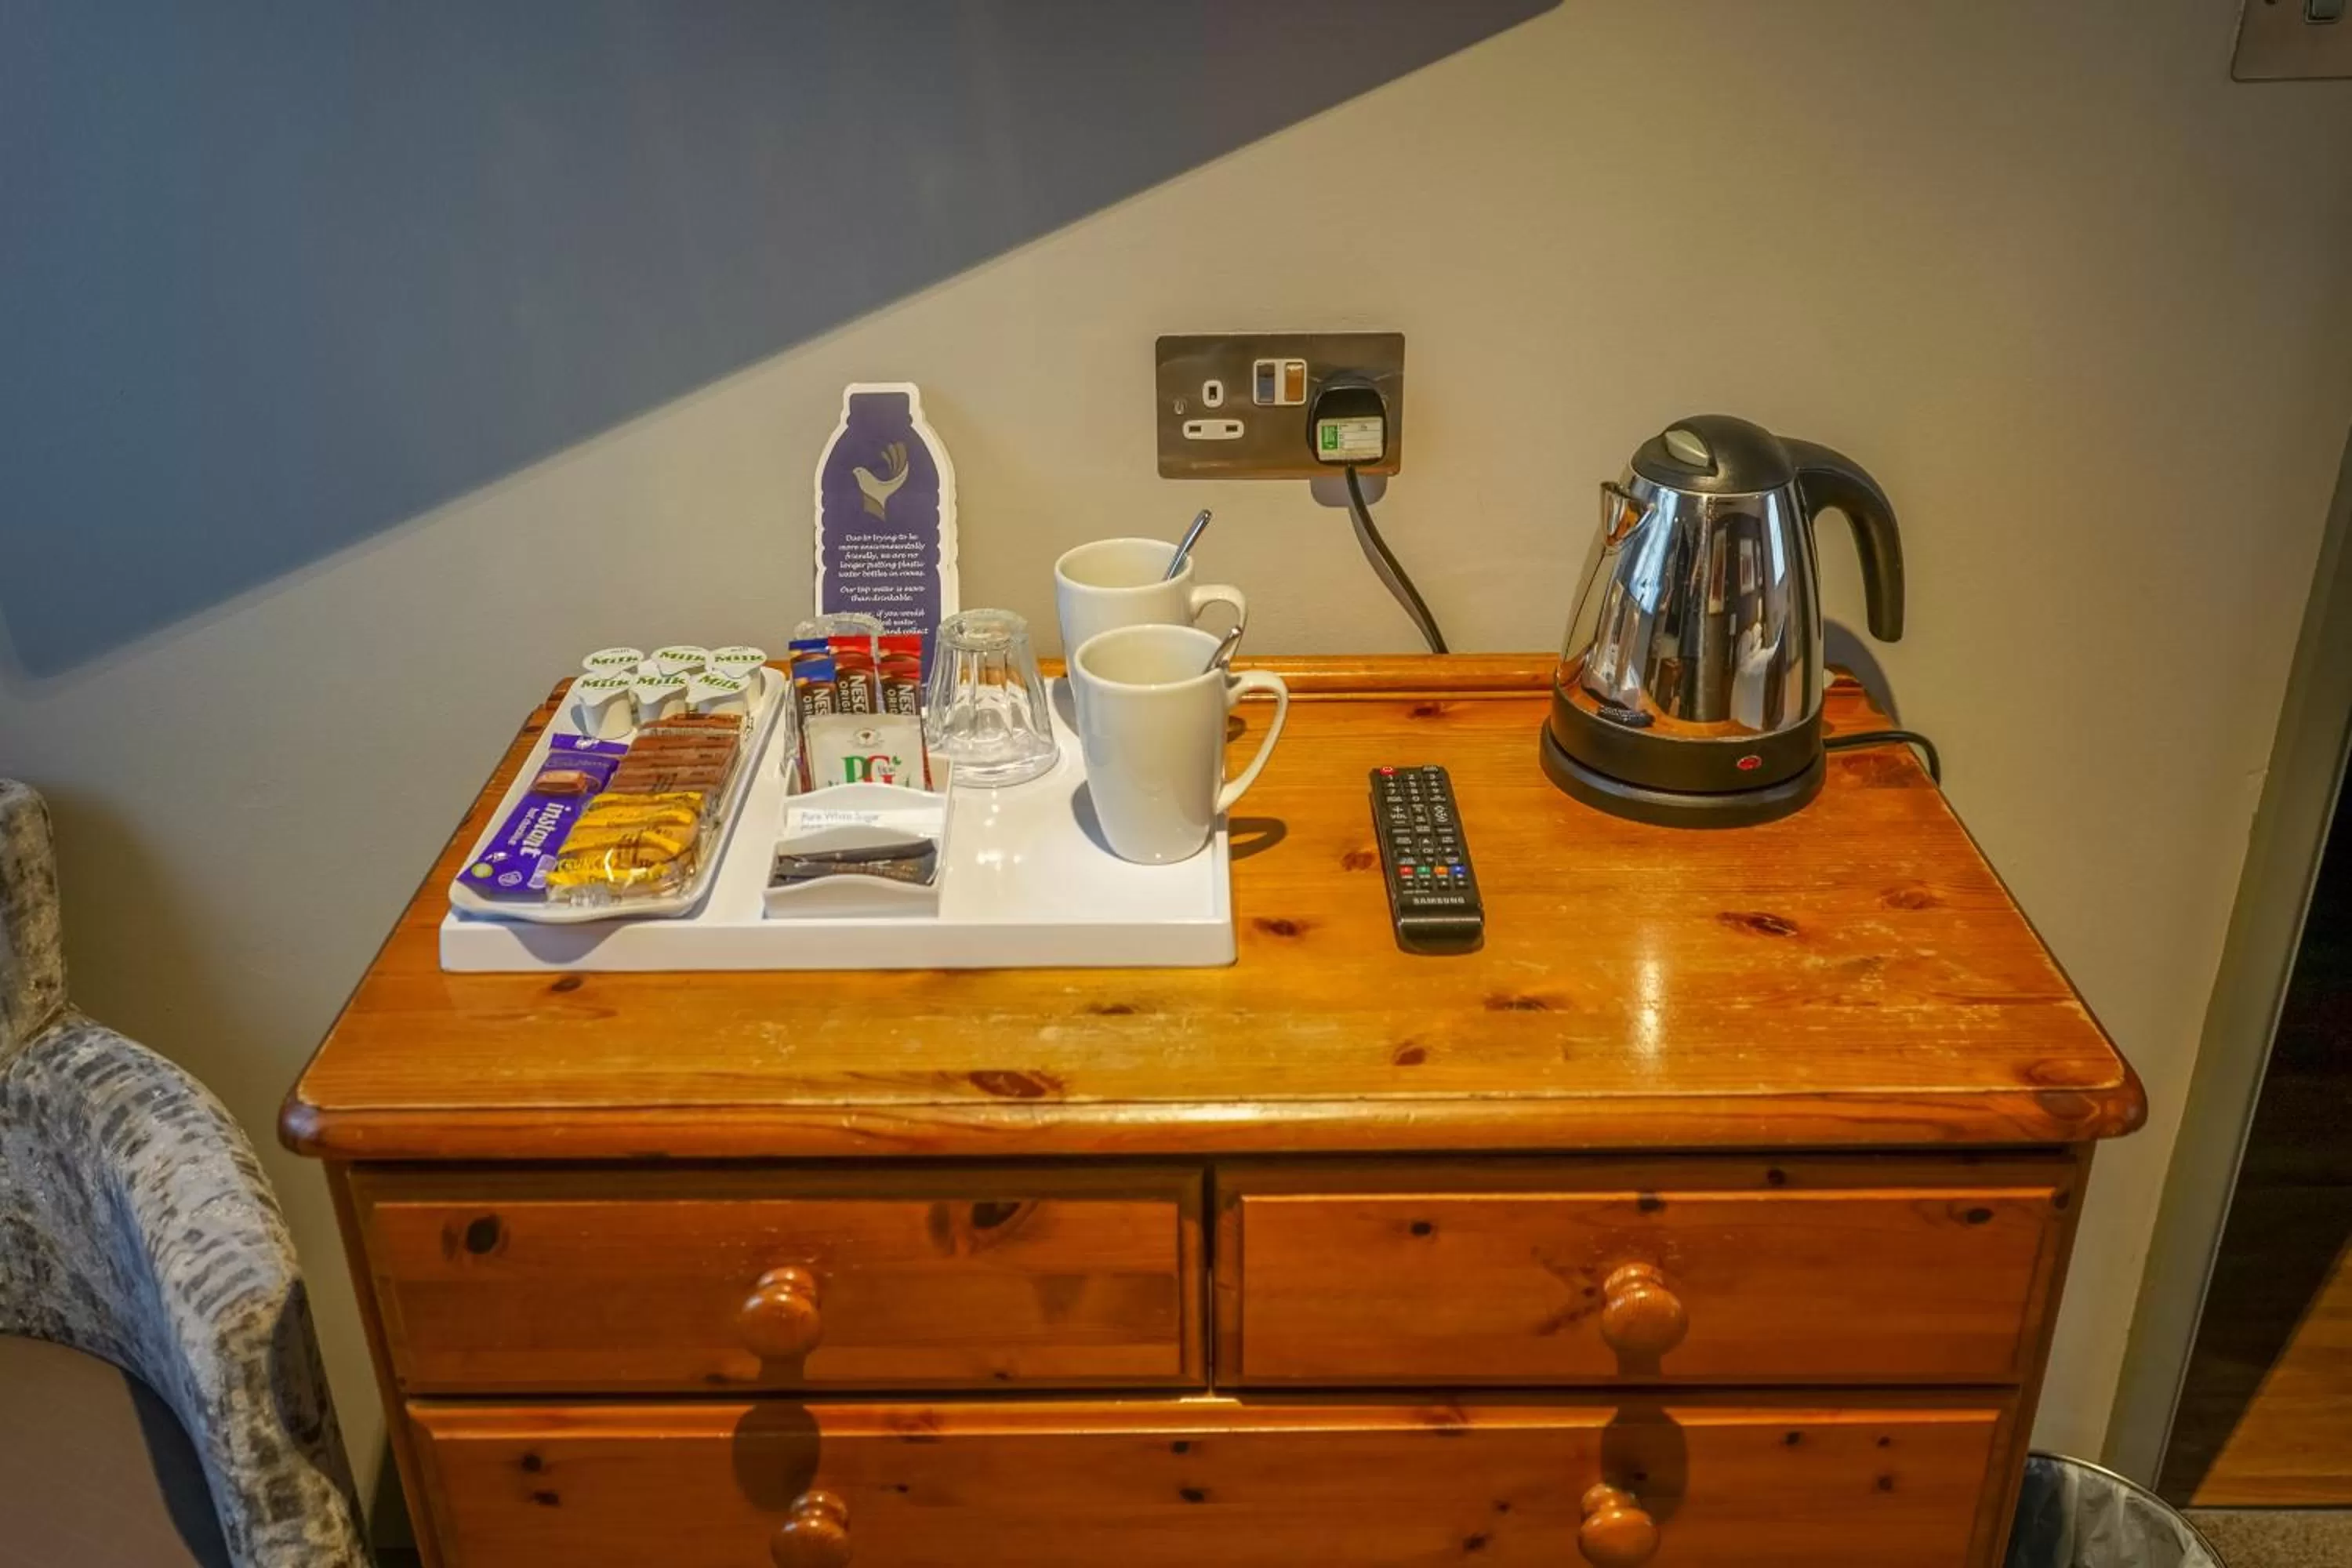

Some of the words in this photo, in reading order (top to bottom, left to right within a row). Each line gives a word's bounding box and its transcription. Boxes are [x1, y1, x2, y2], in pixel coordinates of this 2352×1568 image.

[873, 534, 897, 543] trying
[840, 561, 866, 570] longer
[866, 561, 897, 570] putting
[898, 560, 925, 569] plastic
[862, 569, 887, 578] bottles
[857, 586, 871, 595] tap
[898, 608, 925, 616] would
[591, 655, 639, 666] Milk
[659, 652, 706, 662] Milk
[714, 655, 764, 663] Milk
[581, 678, 630, 688] Milk
[637, 676, 687, 687] Milk
[699, 674, 742, 690] Milk
[839, 681, 851, 714] ORIGI
[850, 675, 869, 715] NESC
[887, 689, 898, 714] ORIG
[842, 754, 895, 784] PG
[825, 811, 852, 821] White
[854, 811, 879, 823] Sugar
[520, 802, 572, 858] instant
[1413, 896, 1465, 905] SAMSUNG
